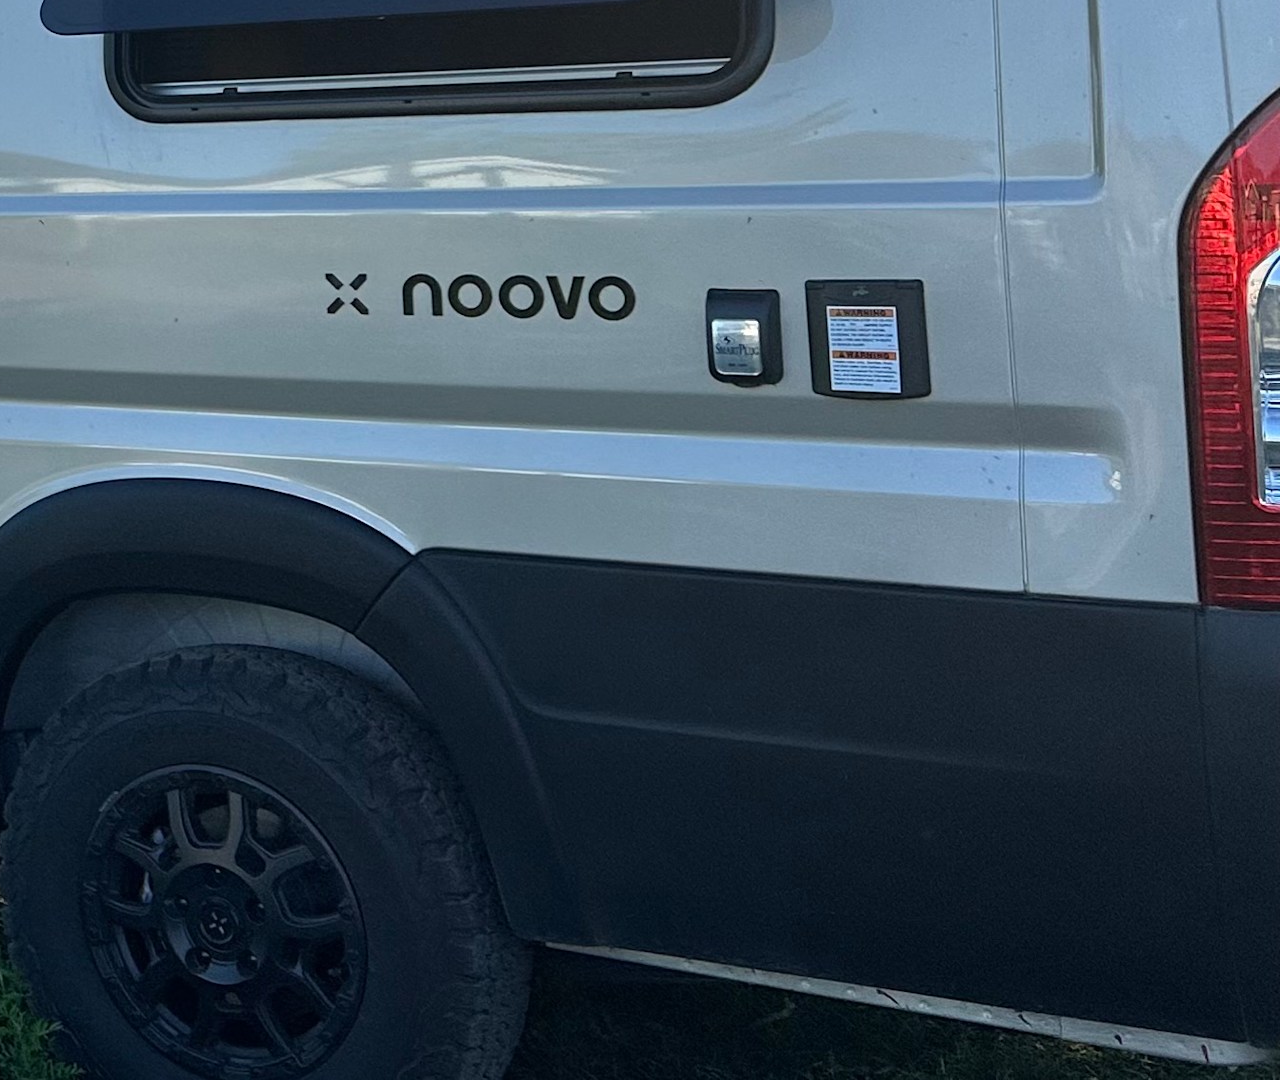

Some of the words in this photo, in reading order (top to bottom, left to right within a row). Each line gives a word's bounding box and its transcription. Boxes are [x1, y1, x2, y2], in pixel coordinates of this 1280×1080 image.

[402, 273, 636, 321] noovo
[842, 309, 886, 317] WARNING
[846, 351, 890, 360] WARNING
